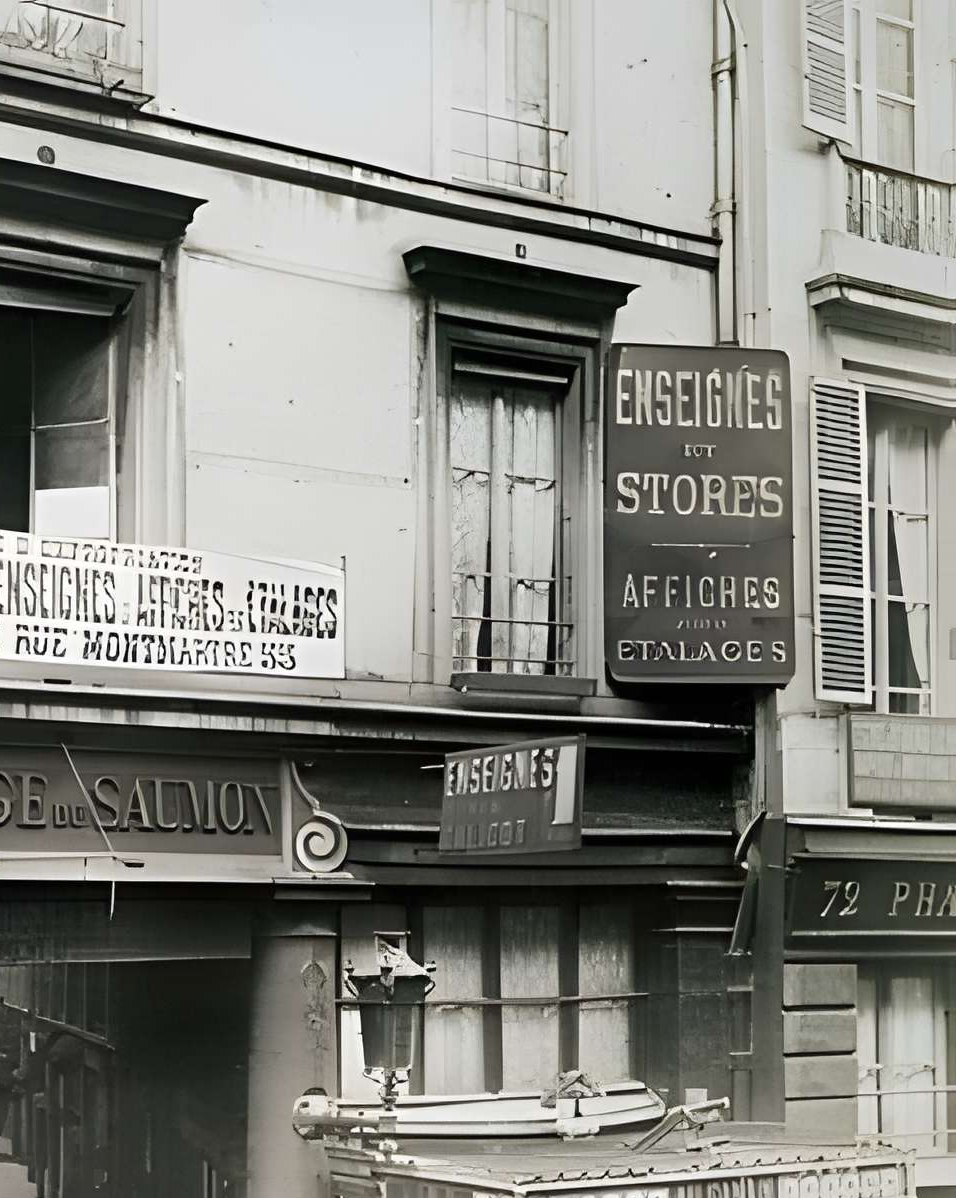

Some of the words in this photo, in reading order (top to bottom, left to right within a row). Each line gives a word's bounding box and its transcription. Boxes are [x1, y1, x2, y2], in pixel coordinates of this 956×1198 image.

[615, 365, 783, 430] ENSEIGNES
[616, 472, 783, 517] STORES
[820, 880, 860, 917] 72
